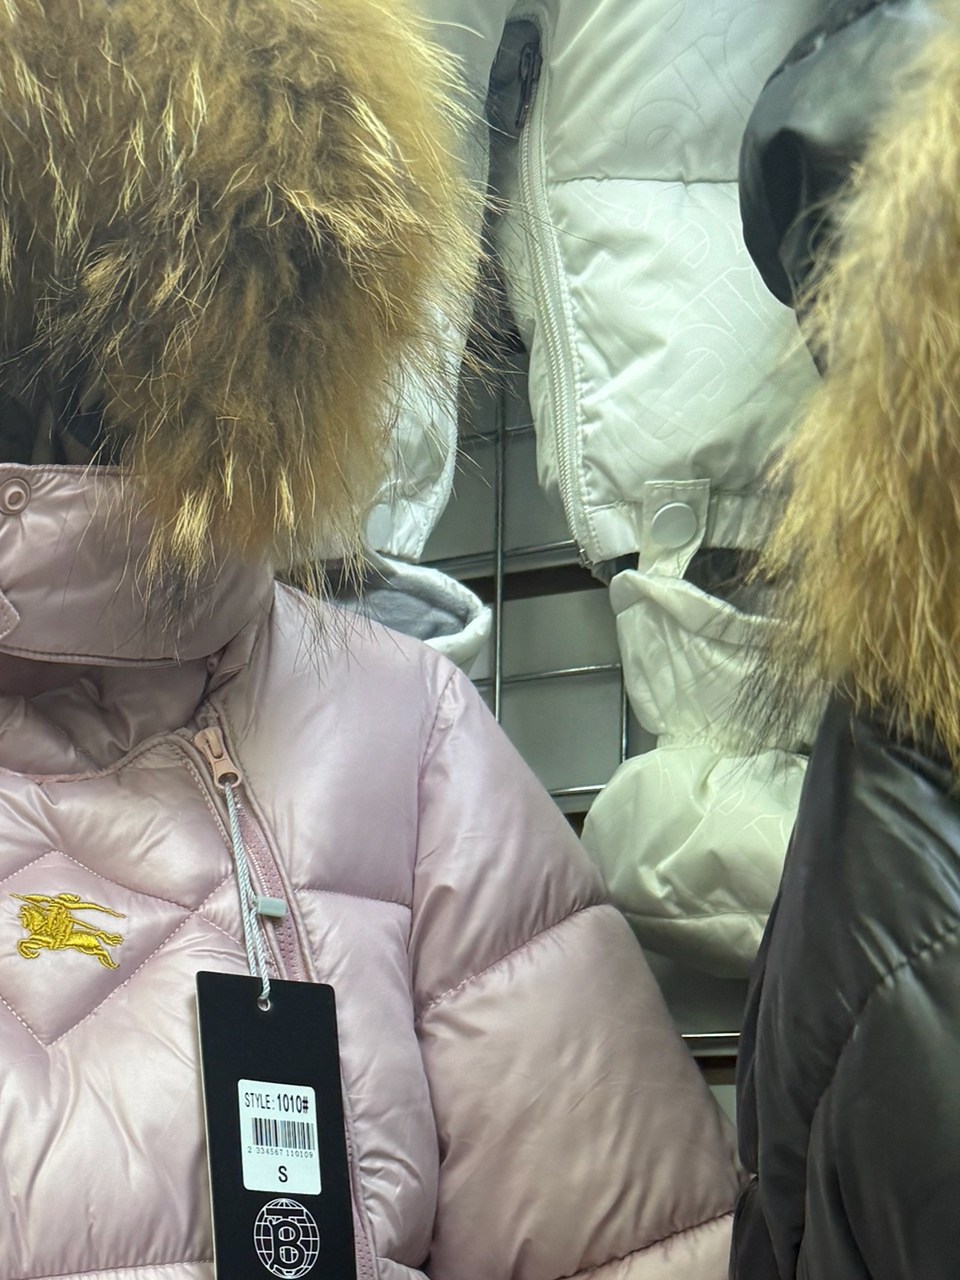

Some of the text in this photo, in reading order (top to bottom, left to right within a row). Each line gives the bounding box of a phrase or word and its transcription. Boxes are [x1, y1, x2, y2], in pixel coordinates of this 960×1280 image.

[247, 1145, 314, 1159] 2 334567 110109
[278, 1165, 288, 1183] S
